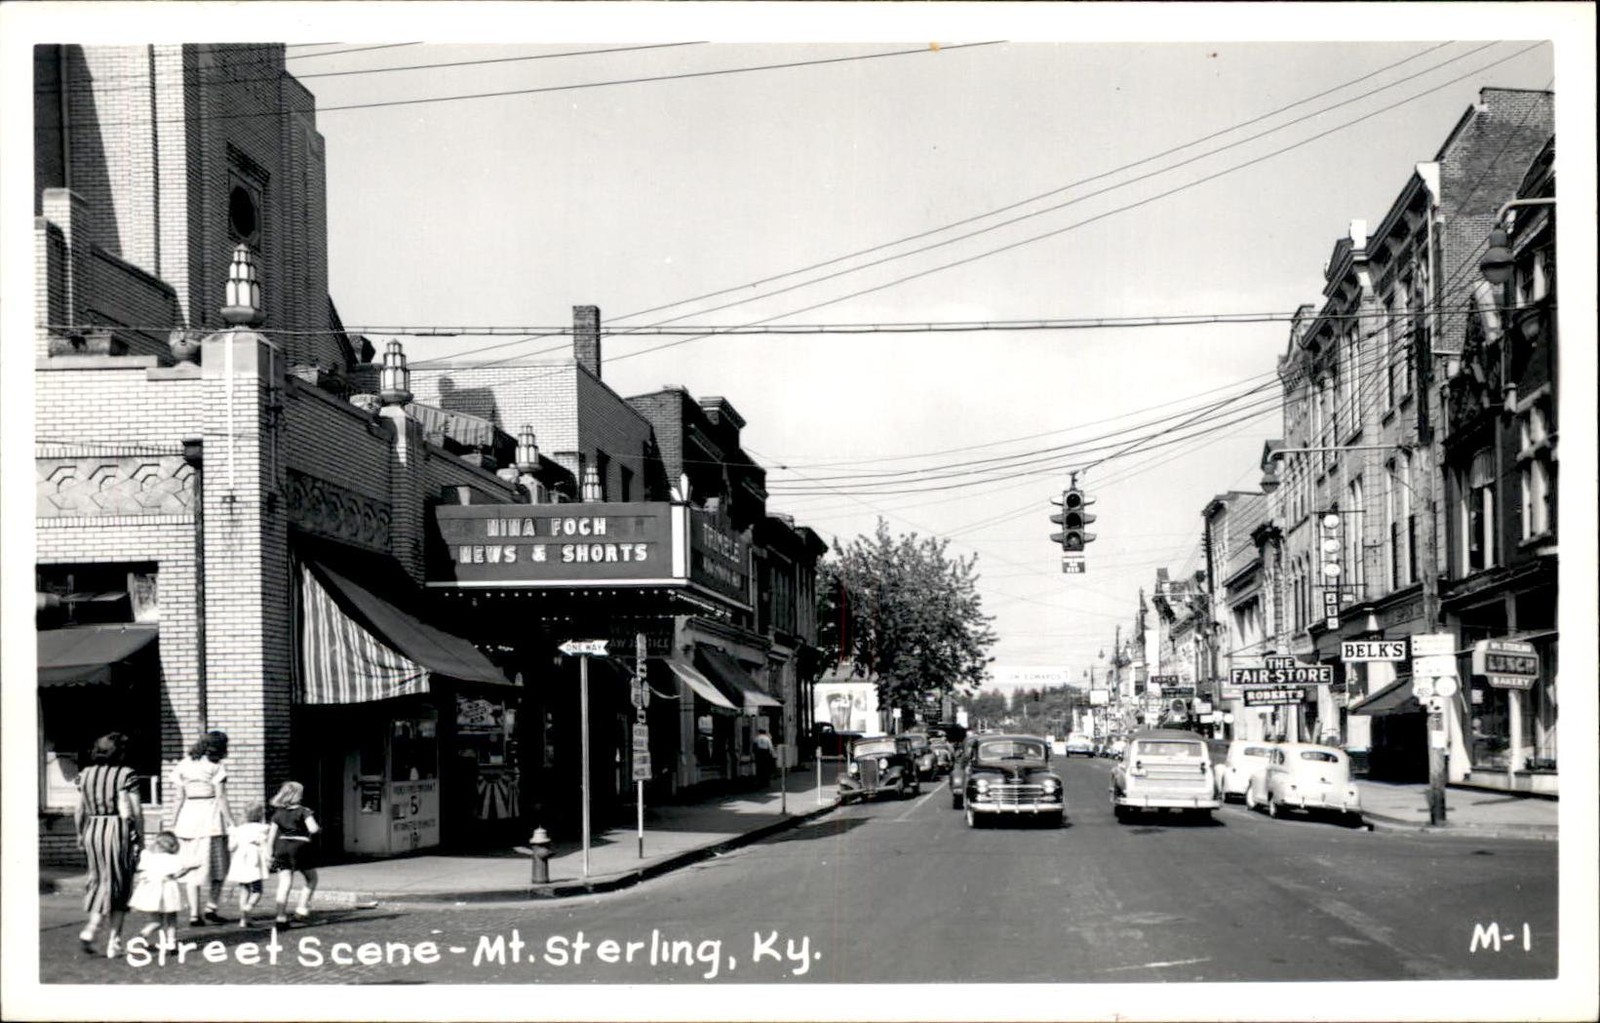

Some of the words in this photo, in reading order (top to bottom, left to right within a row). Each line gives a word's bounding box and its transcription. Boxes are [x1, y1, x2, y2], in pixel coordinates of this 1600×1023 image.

[487, 518, 536, 536] NINA
[551, 517, 607, 536] FOCH
[459, 545, 517, 563] NEWS
[532, 545, 547, 562] &
[562, 543, 648, 563] SHORTS
[566, 642, 582, 652] ONE
[585, 642, 604, 652] WAY
[1344, 643, 1404, 659] BELK'S
[1267, 658, 1296, 669] THE
[1232, 669, 1330, 684] FAIR-STORE
[1246, 690, 1305, 701] ROBERT'S
